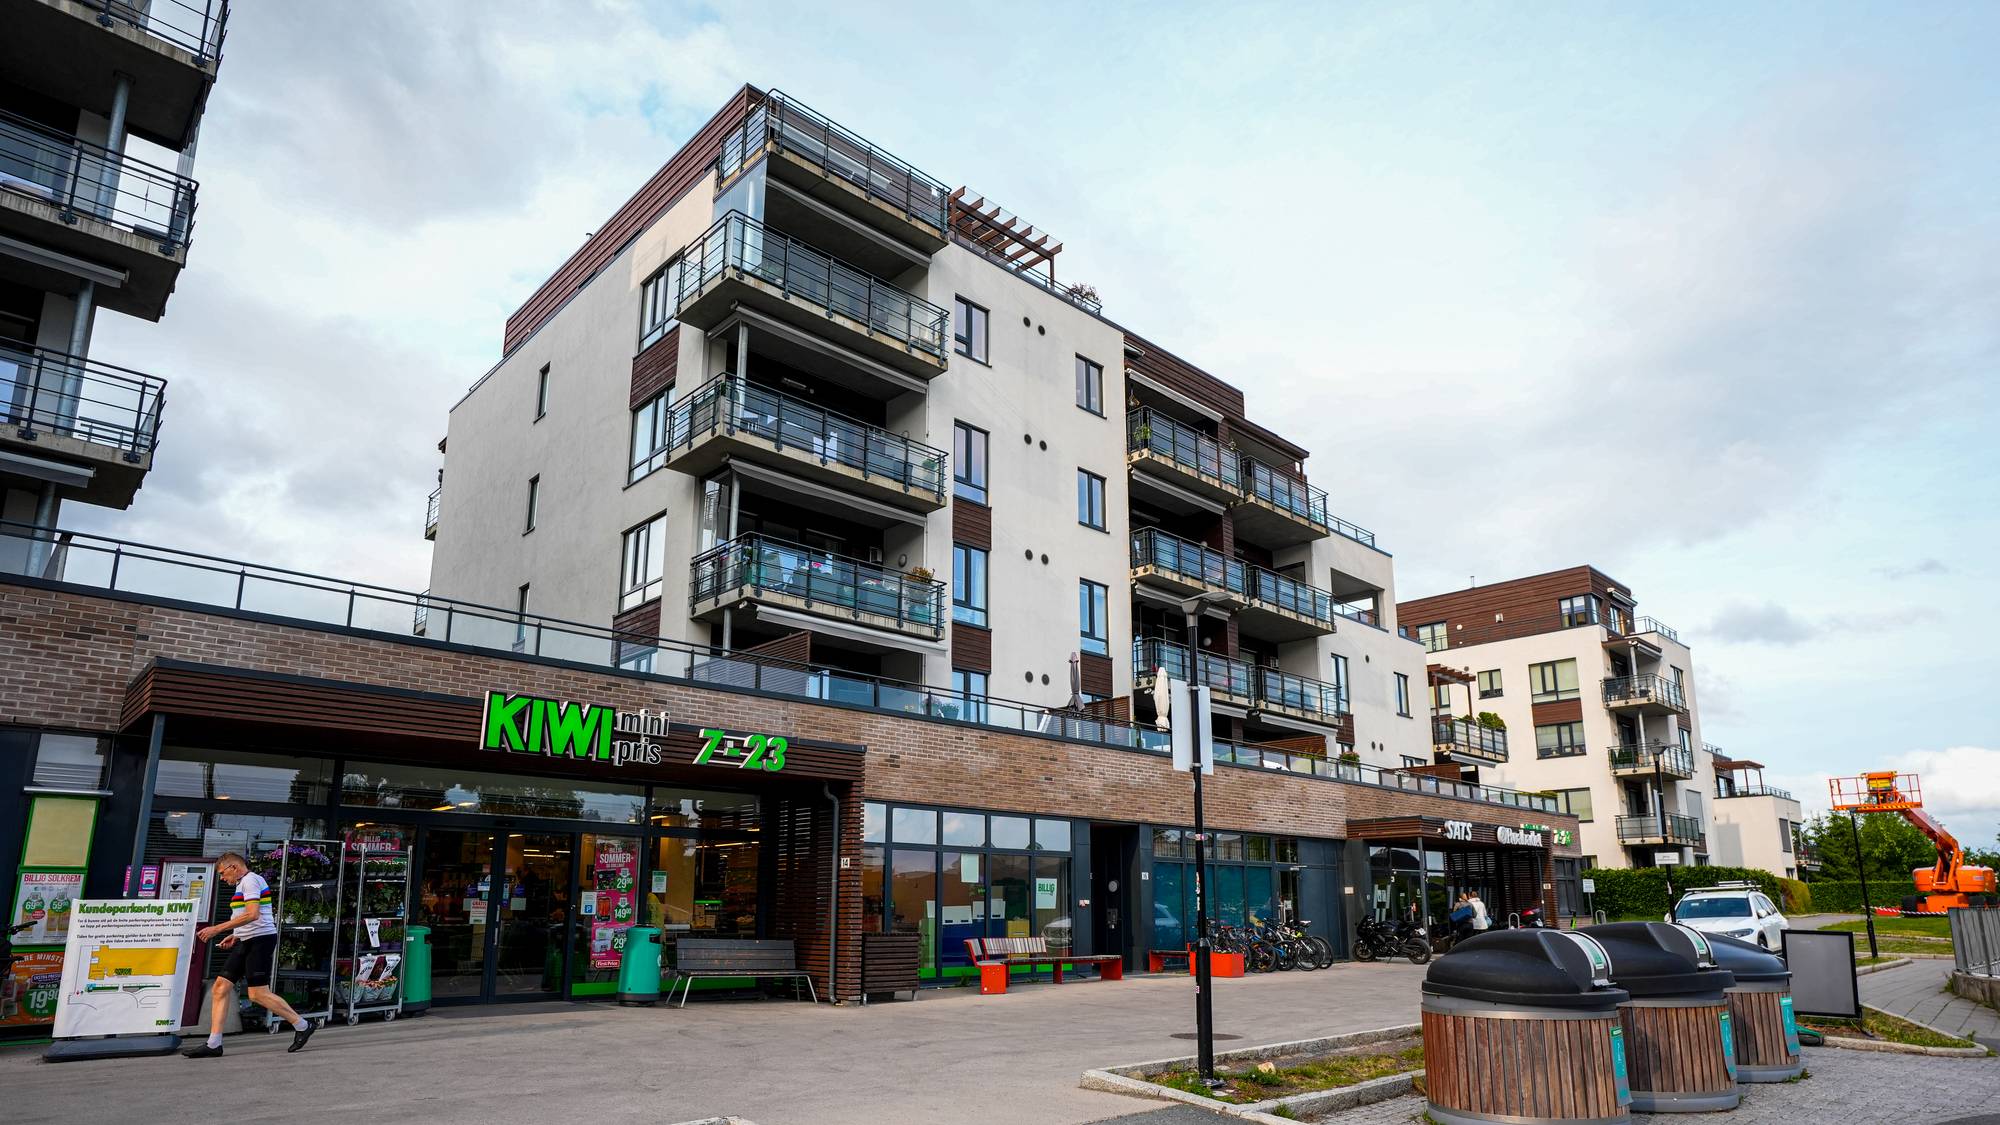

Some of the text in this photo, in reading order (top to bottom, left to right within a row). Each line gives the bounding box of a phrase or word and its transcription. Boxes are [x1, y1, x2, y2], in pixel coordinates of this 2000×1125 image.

[480, 690, 616, 762] KIWI
[617, 709, 670, 736] mini
[613, 737, 662, 766] pris
[692, 728, 788, 772] 7-23
[1444, 820, 1472, 841] SATS
[600, 853, 634, 863] SOMMER-
[24, 874, 81, 882] BILLIG SOLKREM
[1038, 883, 1055, 893] BILLIG
[78, 902, 193, 916] Kundeparkering KIWI
